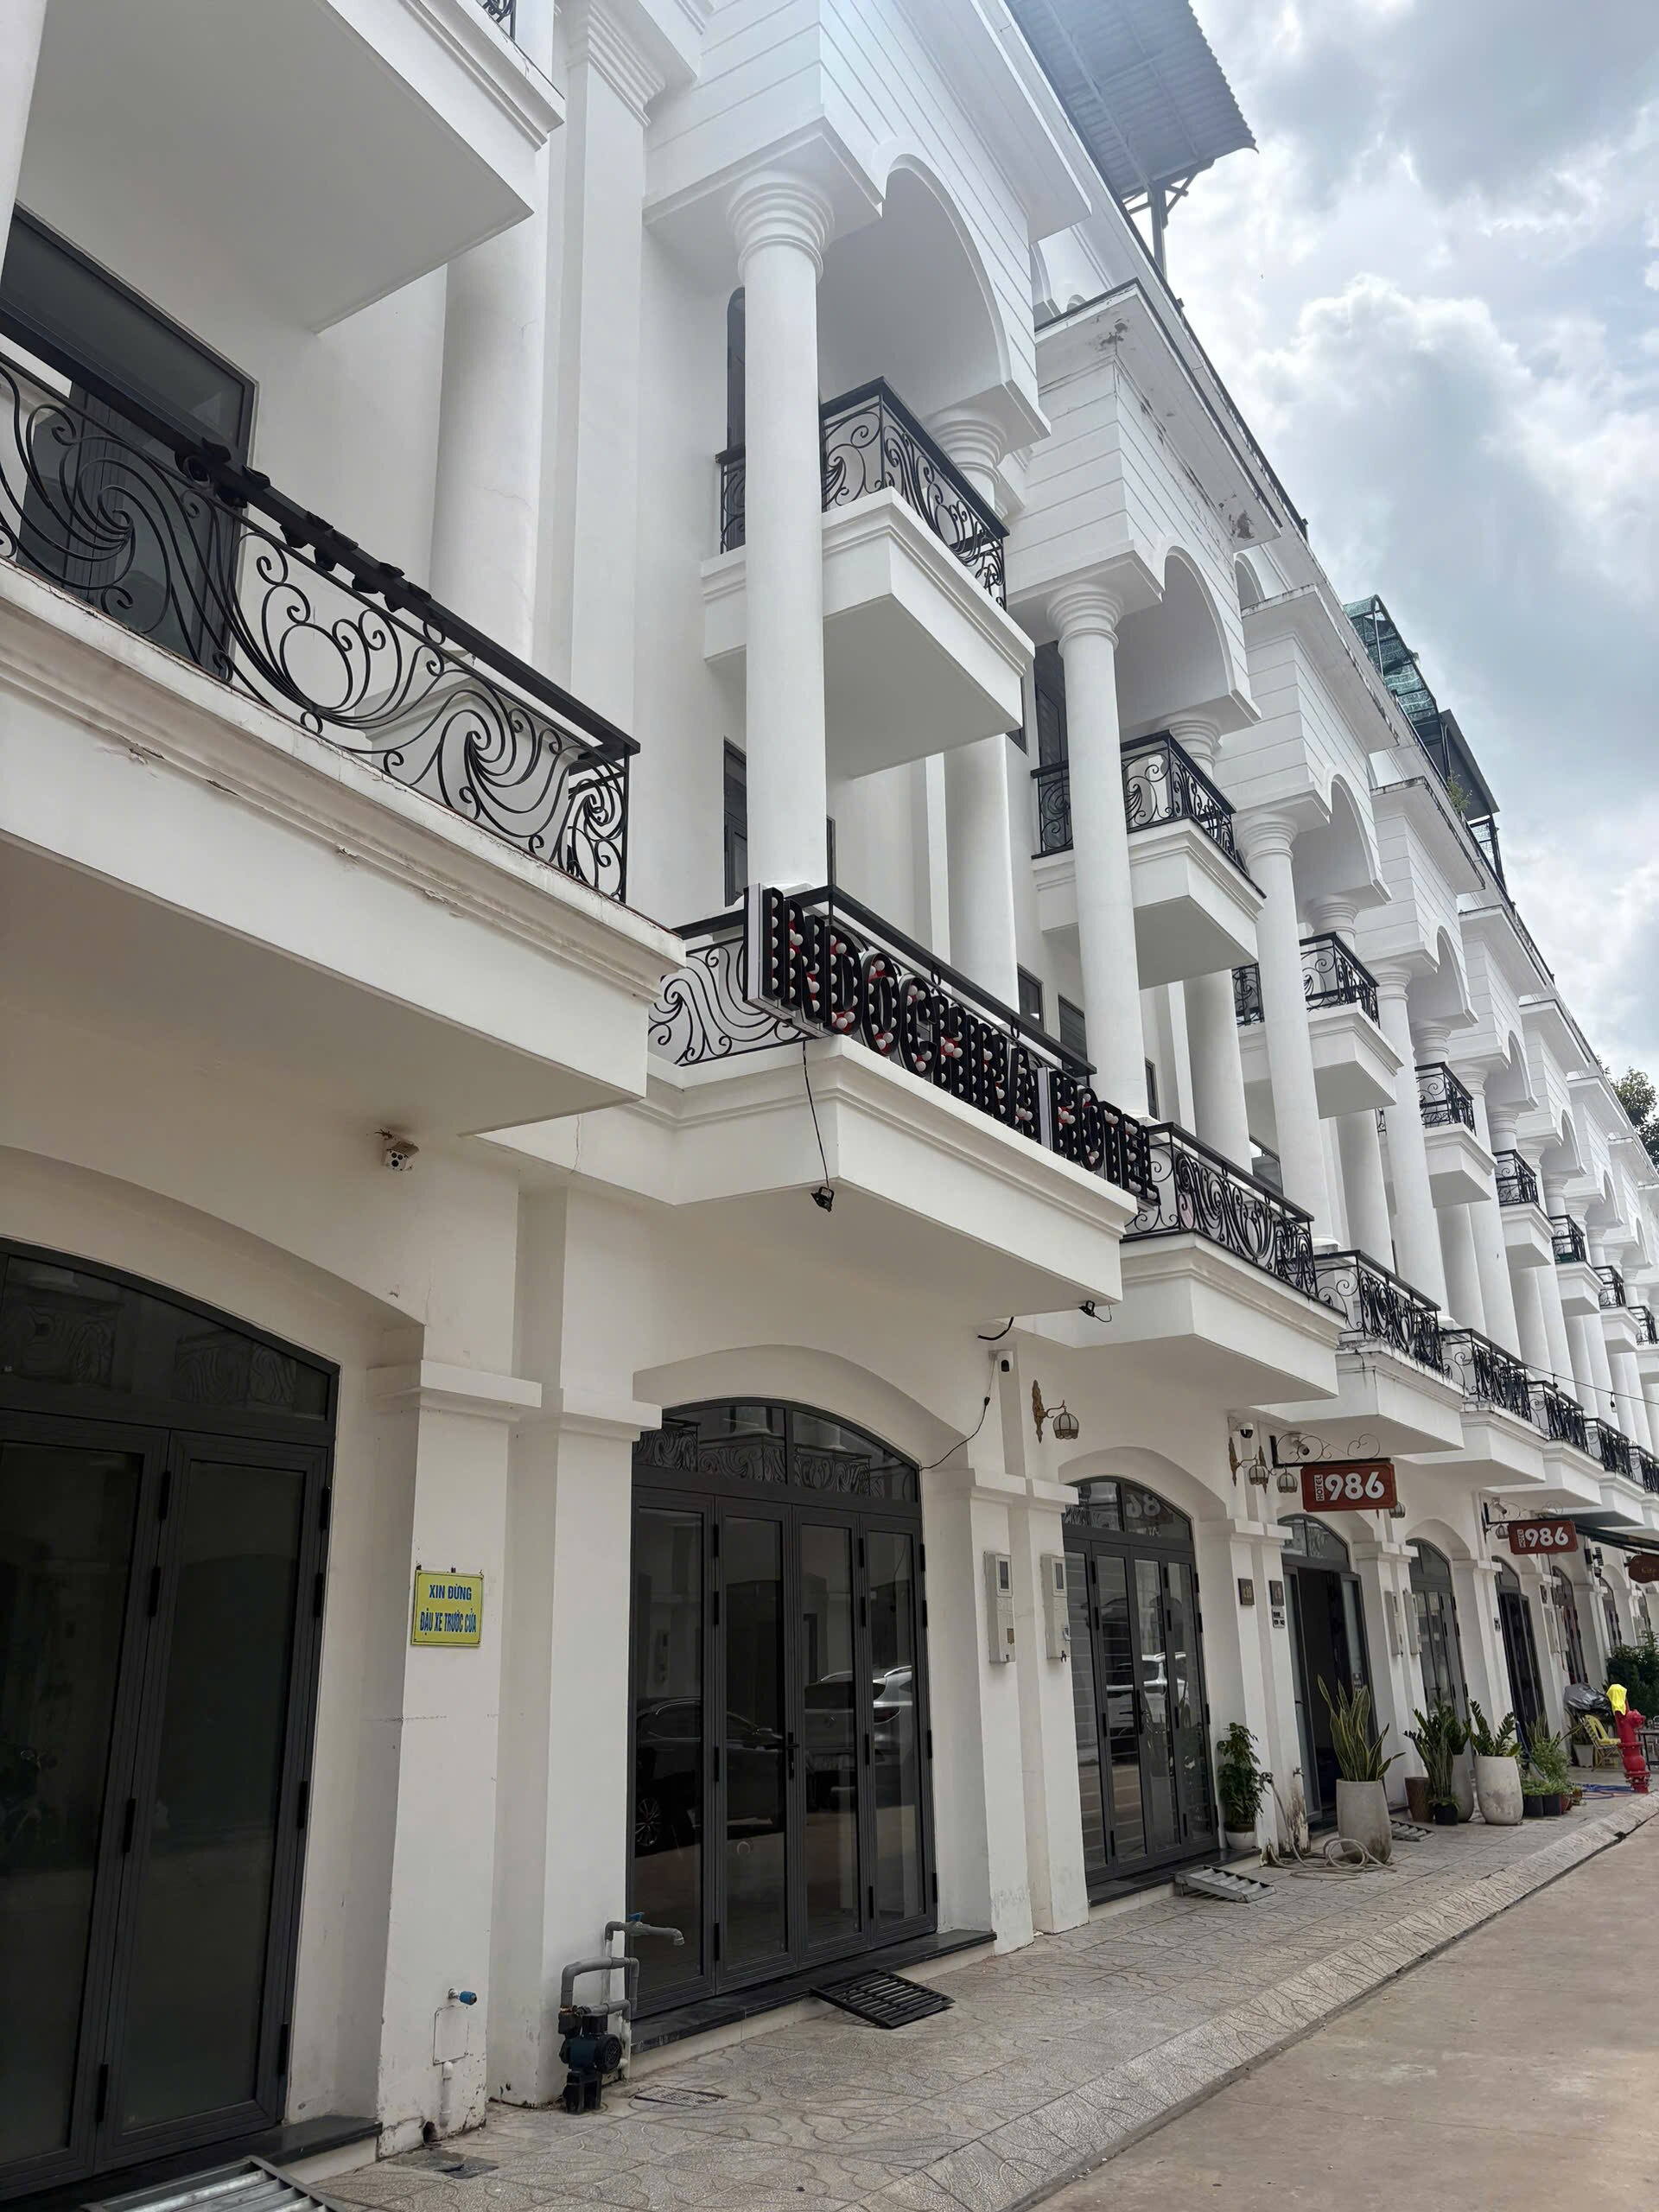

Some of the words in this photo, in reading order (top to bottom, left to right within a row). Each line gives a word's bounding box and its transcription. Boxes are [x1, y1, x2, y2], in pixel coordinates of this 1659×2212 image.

[754, 886, 1039, 1143] INDOCHINA
[1043, 1068, 1161, 1205] HOTEL
[1314, 1475, 1325, 1501] HOTEL
[1325, 1471, 1384, 1500] 986
[1525, 1527, 1569, 1548] 986
[429, 1584, 445, 1599] XIN
[448, 1583, 472, 1601] ĐỪNG
[434, 1611, 443, 1632] XE
